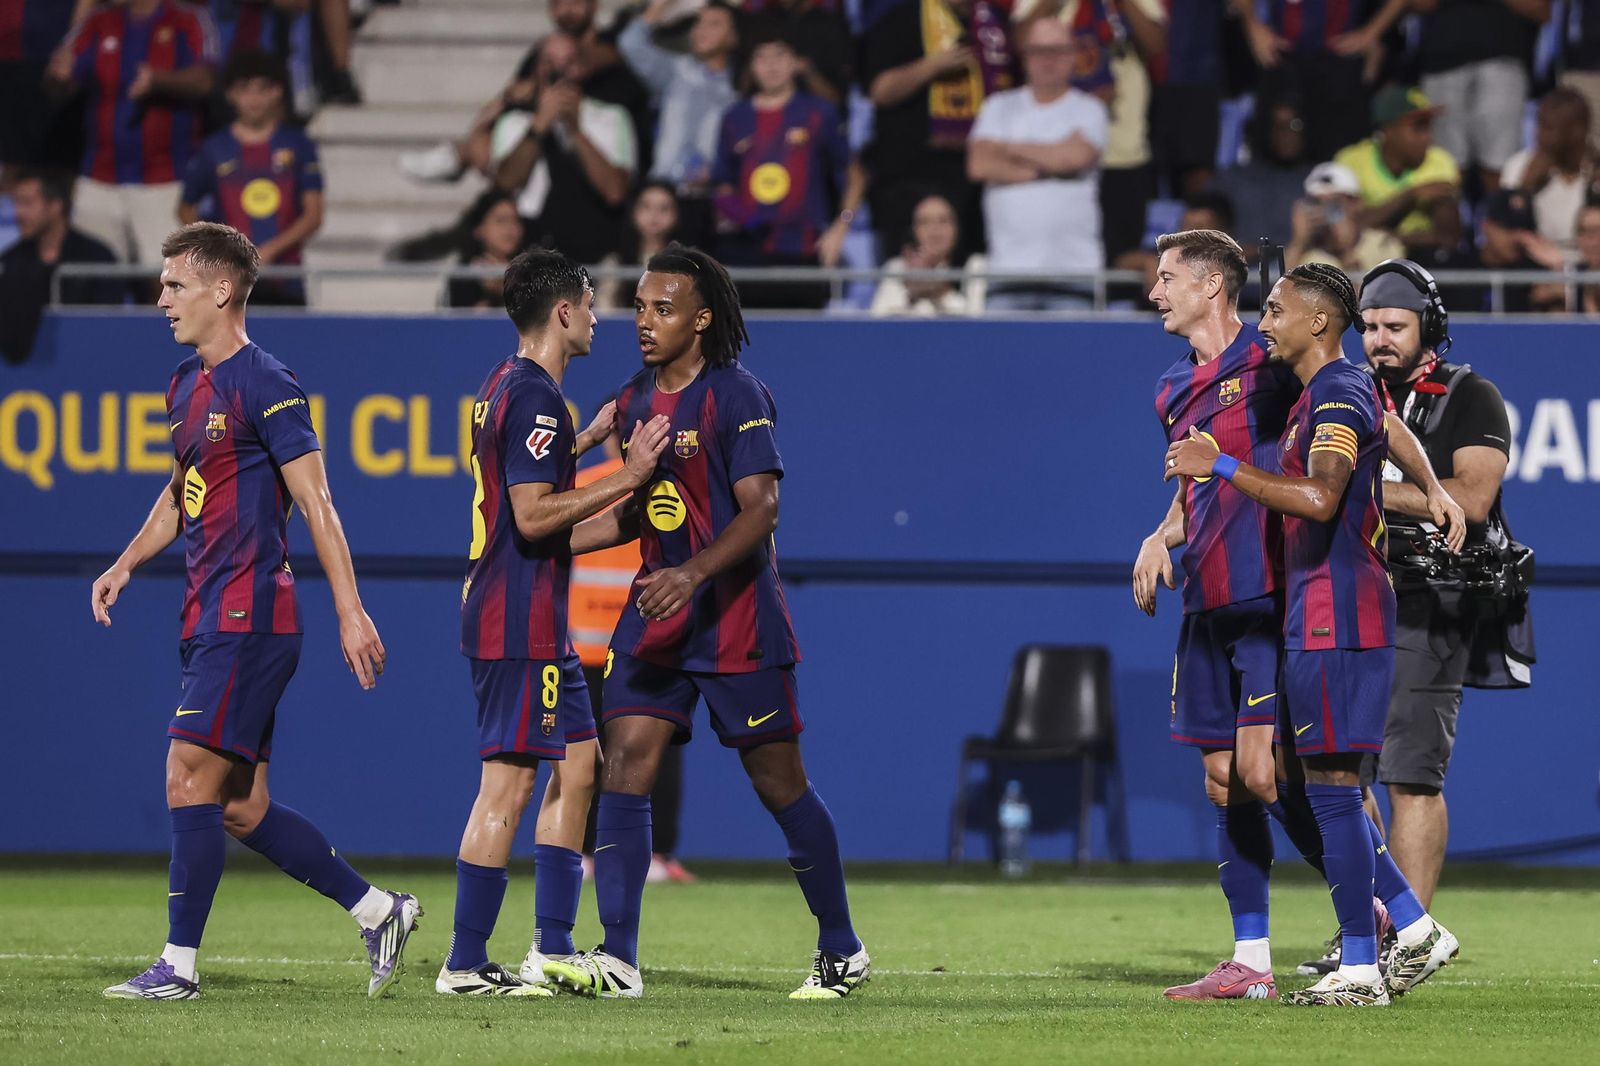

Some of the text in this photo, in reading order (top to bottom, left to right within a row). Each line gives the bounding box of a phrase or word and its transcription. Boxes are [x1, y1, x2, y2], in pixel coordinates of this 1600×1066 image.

[263, 398, 299, 418] AMBILIGHT
[1314, 402, 1355, 413] AMBILIGHT
[0, 390, 173, 490] QUE
[541, 664, 560, 709] 8
